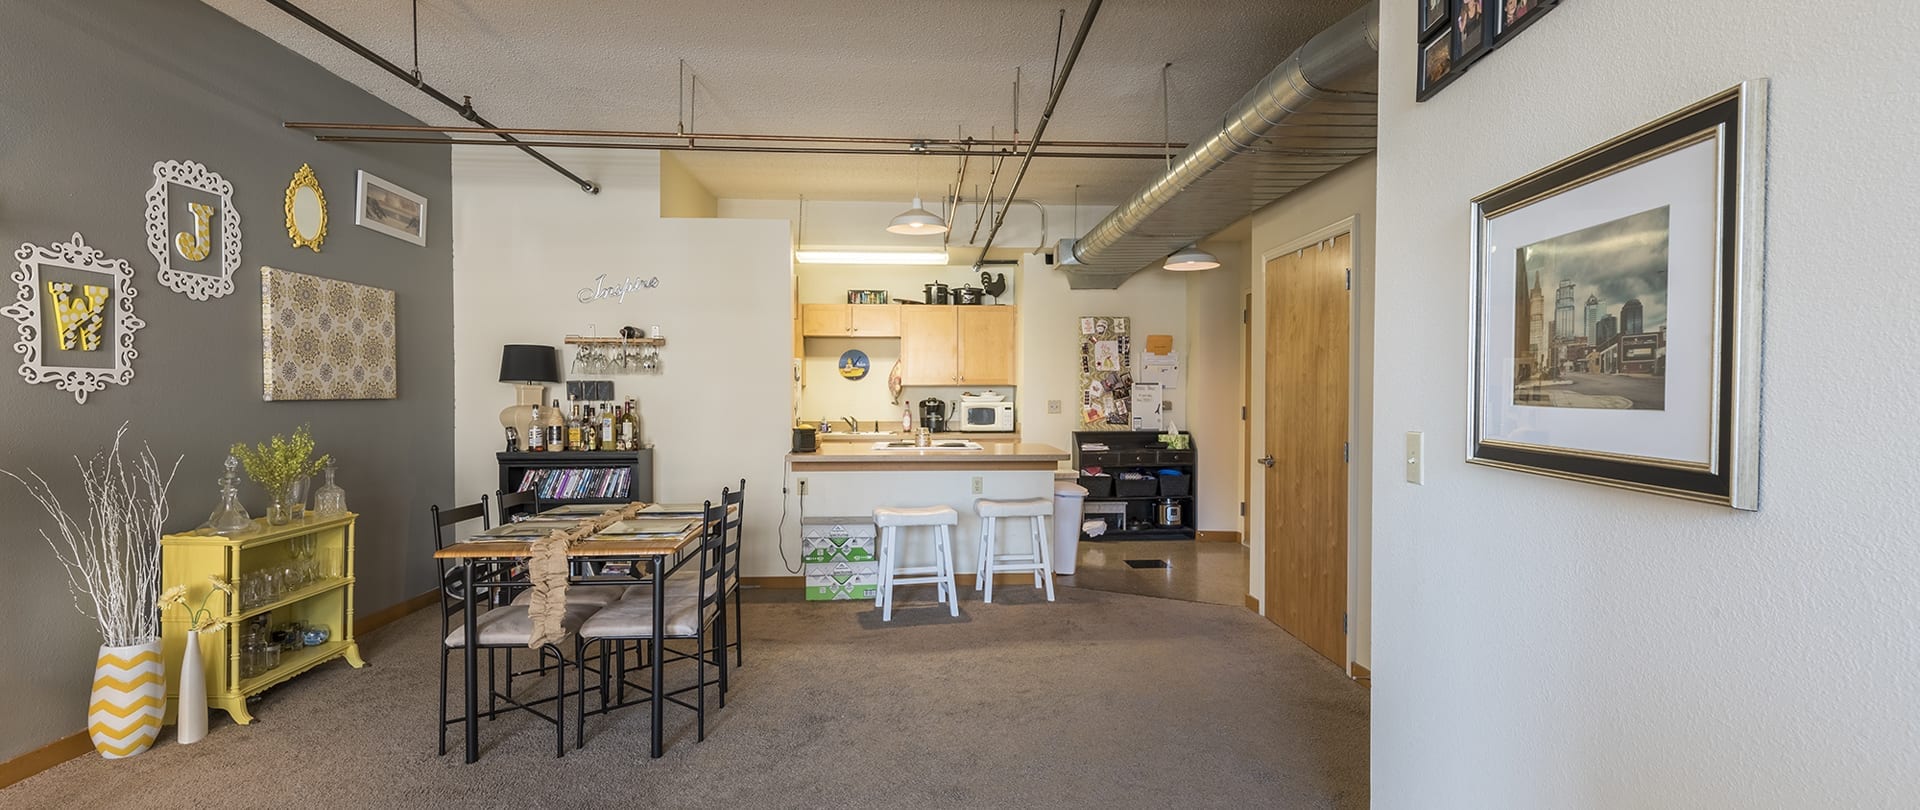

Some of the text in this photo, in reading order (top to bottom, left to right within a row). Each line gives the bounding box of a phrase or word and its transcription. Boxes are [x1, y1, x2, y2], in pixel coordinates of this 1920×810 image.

[175, 202, 215, 262] J
[47, 280, 110, 352] W
[576, 273, 660, 304] Inspire
